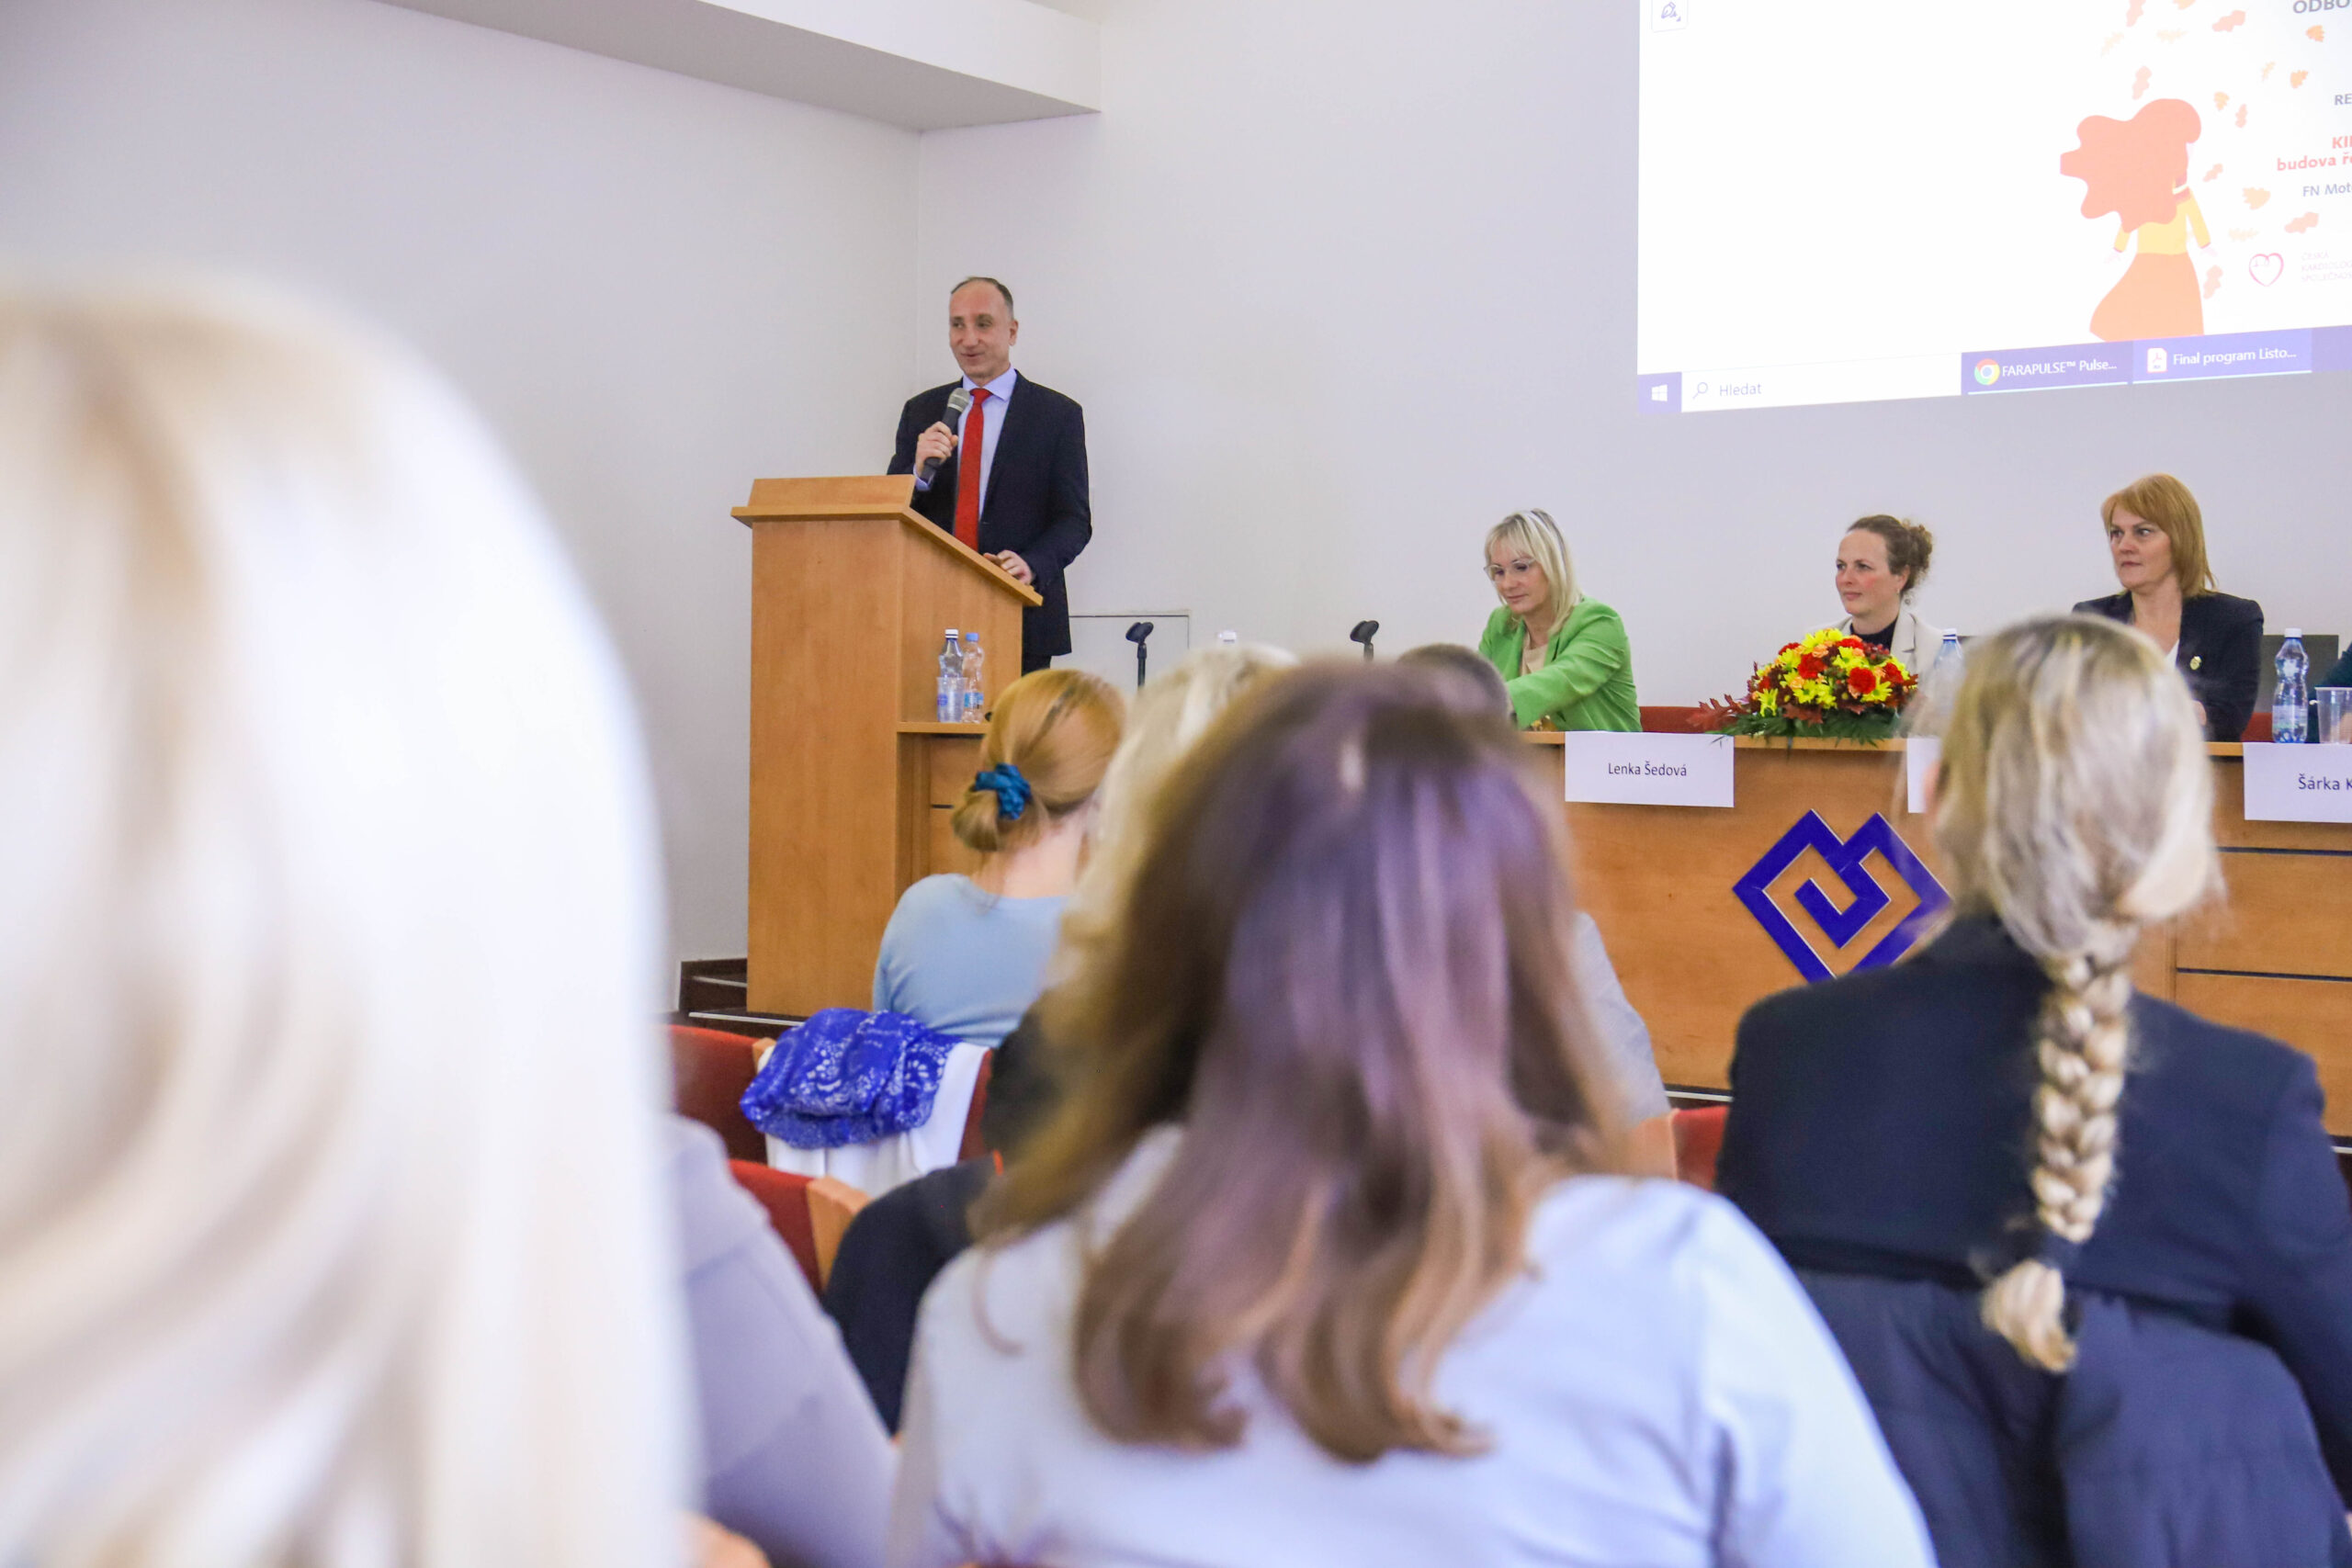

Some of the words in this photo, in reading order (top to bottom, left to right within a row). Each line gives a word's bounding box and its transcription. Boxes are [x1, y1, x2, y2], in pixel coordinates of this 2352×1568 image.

[2332, 135, 2352, 149] KI
[2277, 154, 2336, 171] budova
[2302, 185, 2320, 197] FN
[2324, 182, 2352, 196] Mot
[2173, 352, 2200, 366] Final
[2203, 350, 2256, 366] program
[1719, 382, 1762, 397] Hledat
[1608, 761, 1641, 775] Lenka
[1644, 760, 1687, 776] Šedová
[2298, 773, 2340, 791] Šárka
